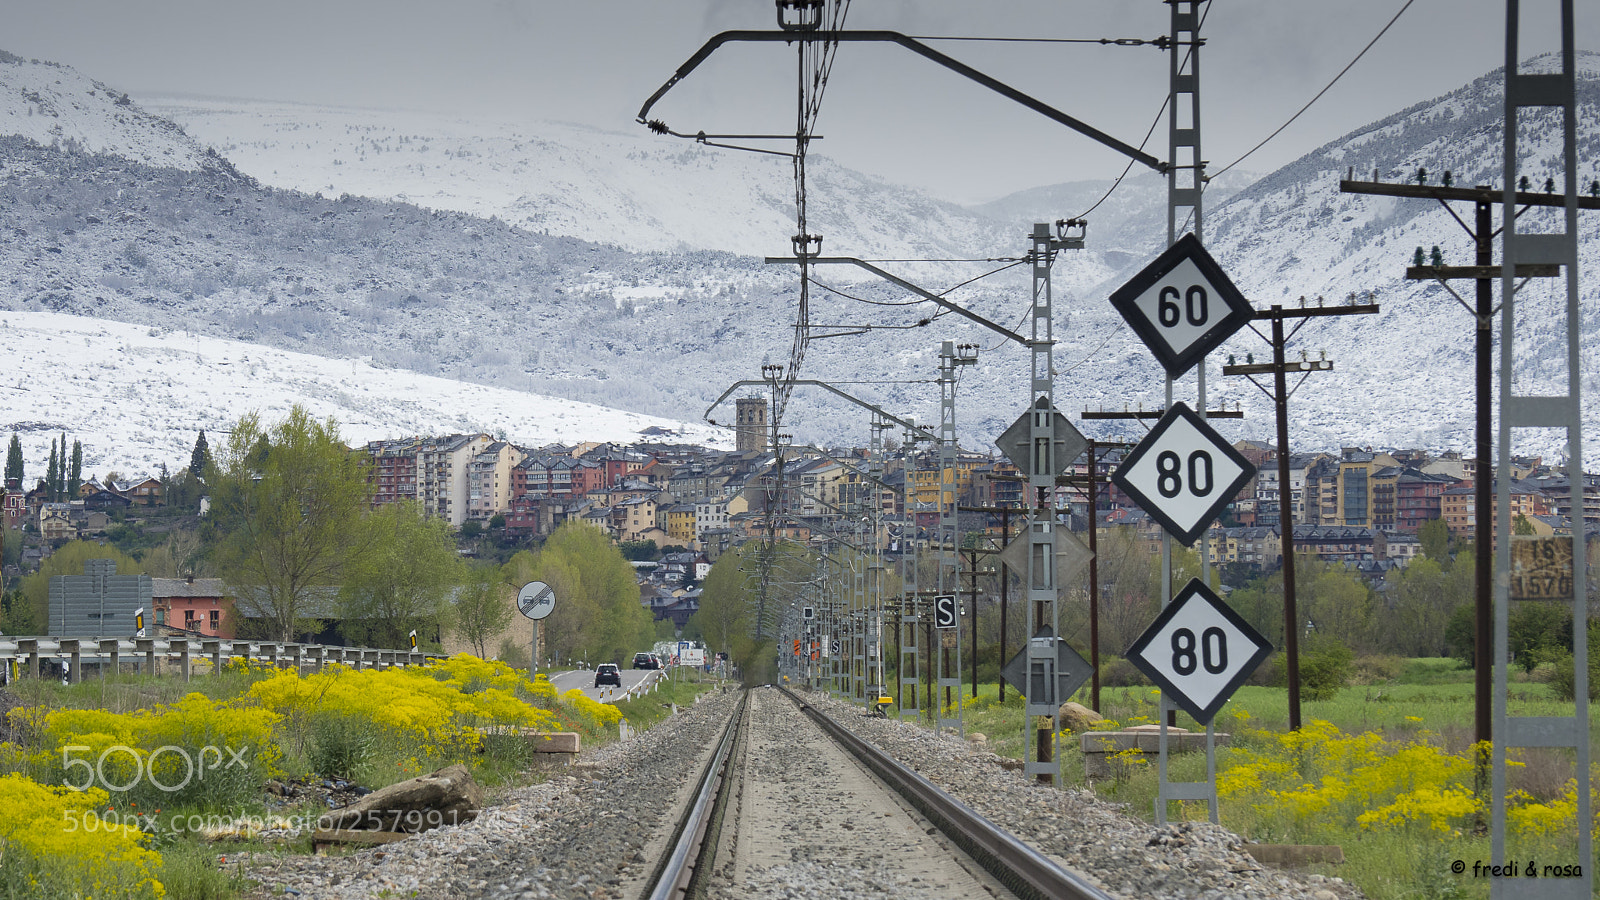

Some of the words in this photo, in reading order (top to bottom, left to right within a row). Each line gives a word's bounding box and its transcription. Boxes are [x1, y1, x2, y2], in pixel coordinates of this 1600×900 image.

[1158, 284, 1209, 328] 60
[1156, 449, 1214, 499] 80
[938, 598, 953, 625] S
[1171, 626, 1228, 676] 80
